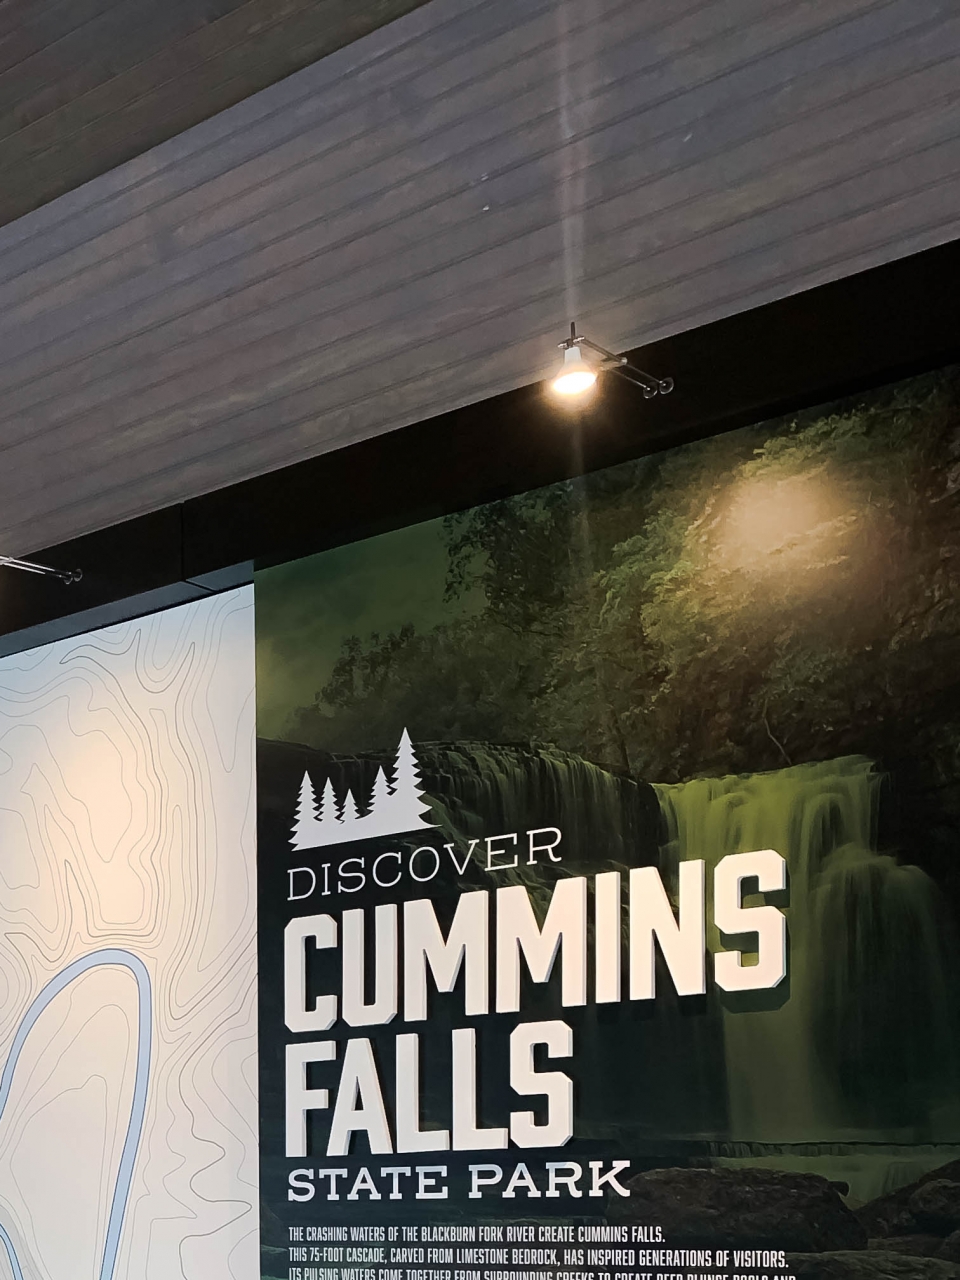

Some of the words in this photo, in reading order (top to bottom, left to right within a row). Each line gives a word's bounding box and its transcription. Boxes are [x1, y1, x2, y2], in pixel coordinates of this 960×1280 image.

[287, 827, 562, 902] DISCOVER
[284, 849, 787, 1033] CUMMINS
[285, 1020, 574, 1158] FALLS
[287, 1165, 449, 1202] STATE
[468, 1160, 631, 1199] PARK
[288, 1226, 304, 1241] THE
[306, 1226, 348, 1241] CRASHING
[349, 1226, 385, 1241] WATERS
[387, 1226, 399, 1241] OF
[401, 1226, 418, 1241] THE
[421, 1226, 475, 1242] BLACKBURN
[478, 1226, 503, 1242] FORK
[506, 1226, 535, 1242] RIVER
[538, 1226, 575, 1242] CREATE
[577, 1226, 628, 1242] CUMMINS
[631, 1225, 665, 1242] FALLS.
[288, 1247, 307, 1261] THIS
[309, 1247, 344, 1262] 75-FOOT
[346, 1247, 387, 1263] CASCADE,
[390, 1247, 424, 1263] CARVED
[427, 1248, 453, 1263] FROM
[456, 1248, 508, 1264] LIMESTONE
[511, 1248, 560, 1266] BEDROCK,
[563, 1249, 584, 1265] HAS
[587, 1249, 635, 1266] INSPIRED
[638, 1249, 714, 1266] GENERATIONS
[715, 1250, 729, 1267] OF
[733, 1250, 789, 1268] VISITORS.
